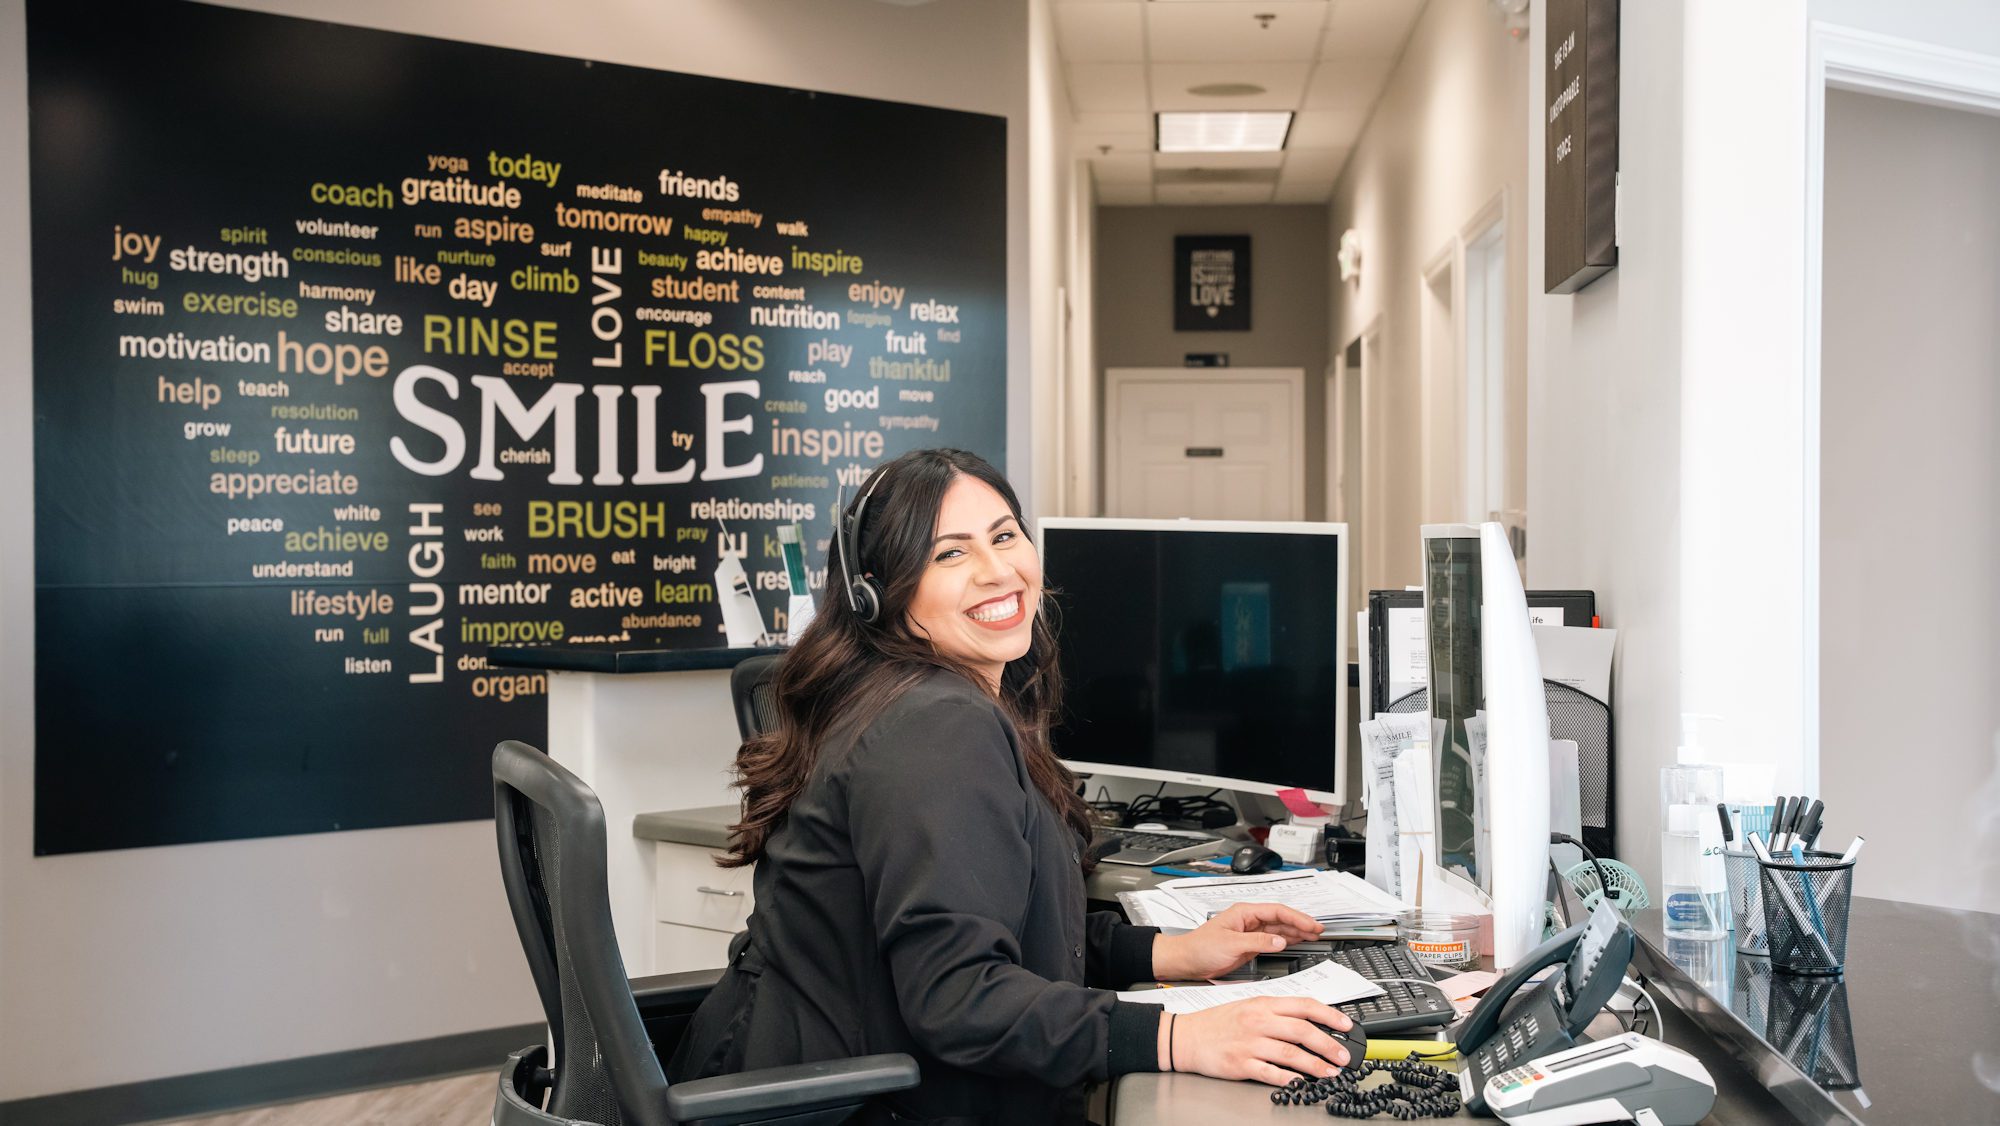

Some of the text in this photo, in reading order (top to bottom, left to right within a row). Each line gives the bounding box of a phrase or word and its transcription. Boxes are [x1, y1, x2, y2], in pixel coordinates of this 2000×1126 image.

[1554, 31, 1575, 70] SHE IS AN
[1550, 75, 1580, 123] UNSTOPPABLE
[1557, 134, 1571, 164] FORCE
[428, 154, 468, 173] yoga
[488, 151, 561, 188] today
[311, 183, 393, 209] coach
[401, 177, 521, 209] gratitude
[577, 184, 642, 202] meditate
[659, 170, 739, 201] friends
[556, 202, 672, 236] tomorrow
[703, 207, 762, 228] empathy
[221, 226, 267, 245] spirit
[296, 219, 378, 239] volunteer
[415, 223, 441, 238] run
[455, 216, 534, 245] aspire
[684, 225, 728, 245] happy
[777, 221, 808, 237] walk
[113, 225, 161, 263] joy
[541, 241, 571, 258] surf
[170, 246, 288, 282] strength
[293, 247, 381, 266] conscious
[438, 250, 495, 267] nurture
[639, 250, 688, 271] beauty
[696, 249, 783, 275] achieve
[792, 246, 862, 276] inspire
[122, 267, 159, 289] hug
[395, 256, 441, 284] like
[510, 265, 580, 294] climb
[300, 282, 375, 304] harmony
[449, 275, 498, 307] day
[652, 276, 739, 303] student
[753, 284, 804, 300] content
[849, 281, 904, 309] enjoy
[1191, 285, 1235, 306] LOVE
[114, 297, 164, 315] swim
[183, 292, 298, 318] exercise
[592, 247, 622, 368] LOVE
[636, 307, 712, 325] encourage
[910, 300, 959, 323] relax
[325, 306, 402, 335] share
[751, 303, 840, 330] nutrition
[848, 310, 891, 326] forgive
[423, 314, 558, 360] RINSE
[886, 330, 926, 355] fruit
[938, 329, 960, 343] find
[120, 334, 270, 363] motivation
[278, 331, 389, 384] hope
[645, 329, 764, 372] FLOSS
[808, 339, 852, 367] play
[503, 361, 554, 379] accept
[789, 369, 826, 383] reach
[870, 357, 950, 382] thankful
[158, 377, 221, 409] help
[238, 380, 289, 397] teach
[825, 386, 878, 413] good
[899, 389, 933, 402] move
[272, 405, 358, 420] resolution
[765, 399, 806, 413] create
[184, 423, 231, 439] grow
[390, 364, 764, 486] SMILE
[879, 414, 939, 432] sympathy
[275, 428, 355, 454] future
[672, 431, 693, 451] try
[772, 420, 883, 464] inspire
[210, 448, 260, 466] sleep
[500, 448, 550, 464] cherish
[210, 469, 358, 499] appreciate
[771, 473, 828, 488] patience
[334, 505, 380, 521] white
[473, 503, 502, 516] see
[528, 501, 664, 538] BRUSH
[691, 498, 815, 523] relationships
[228, 517, 283, 535] peace
[465, 527, 503, 542] work
[677, 526, 708, 542] pray
[285, 526, 389, 552] achieve
[481, 554, 516, 569] faith
[528, 552, 596, 573] move
[612, 549, 635, 564] eat
[654, 555, 695, 573] bright
[253, 561, 353, 578] understand
[408, 503, 444, 684] LAUGH
[459, 581, 550, 604] mentor
[570, 582, 642, 608] active
[655, 580, 712, 603] learn
[291, 590, 393, 620] lifestyle
[622, 612, 701, 628] abundance
[1531, 616, 1544, 624] ife
[315, 628, 344, 642] run
[363, 628, 389, 644] full
[461, 617, 564, 646] improve
[345, 657, 391, 674] listen
[472, 674, 548, 702] organ
